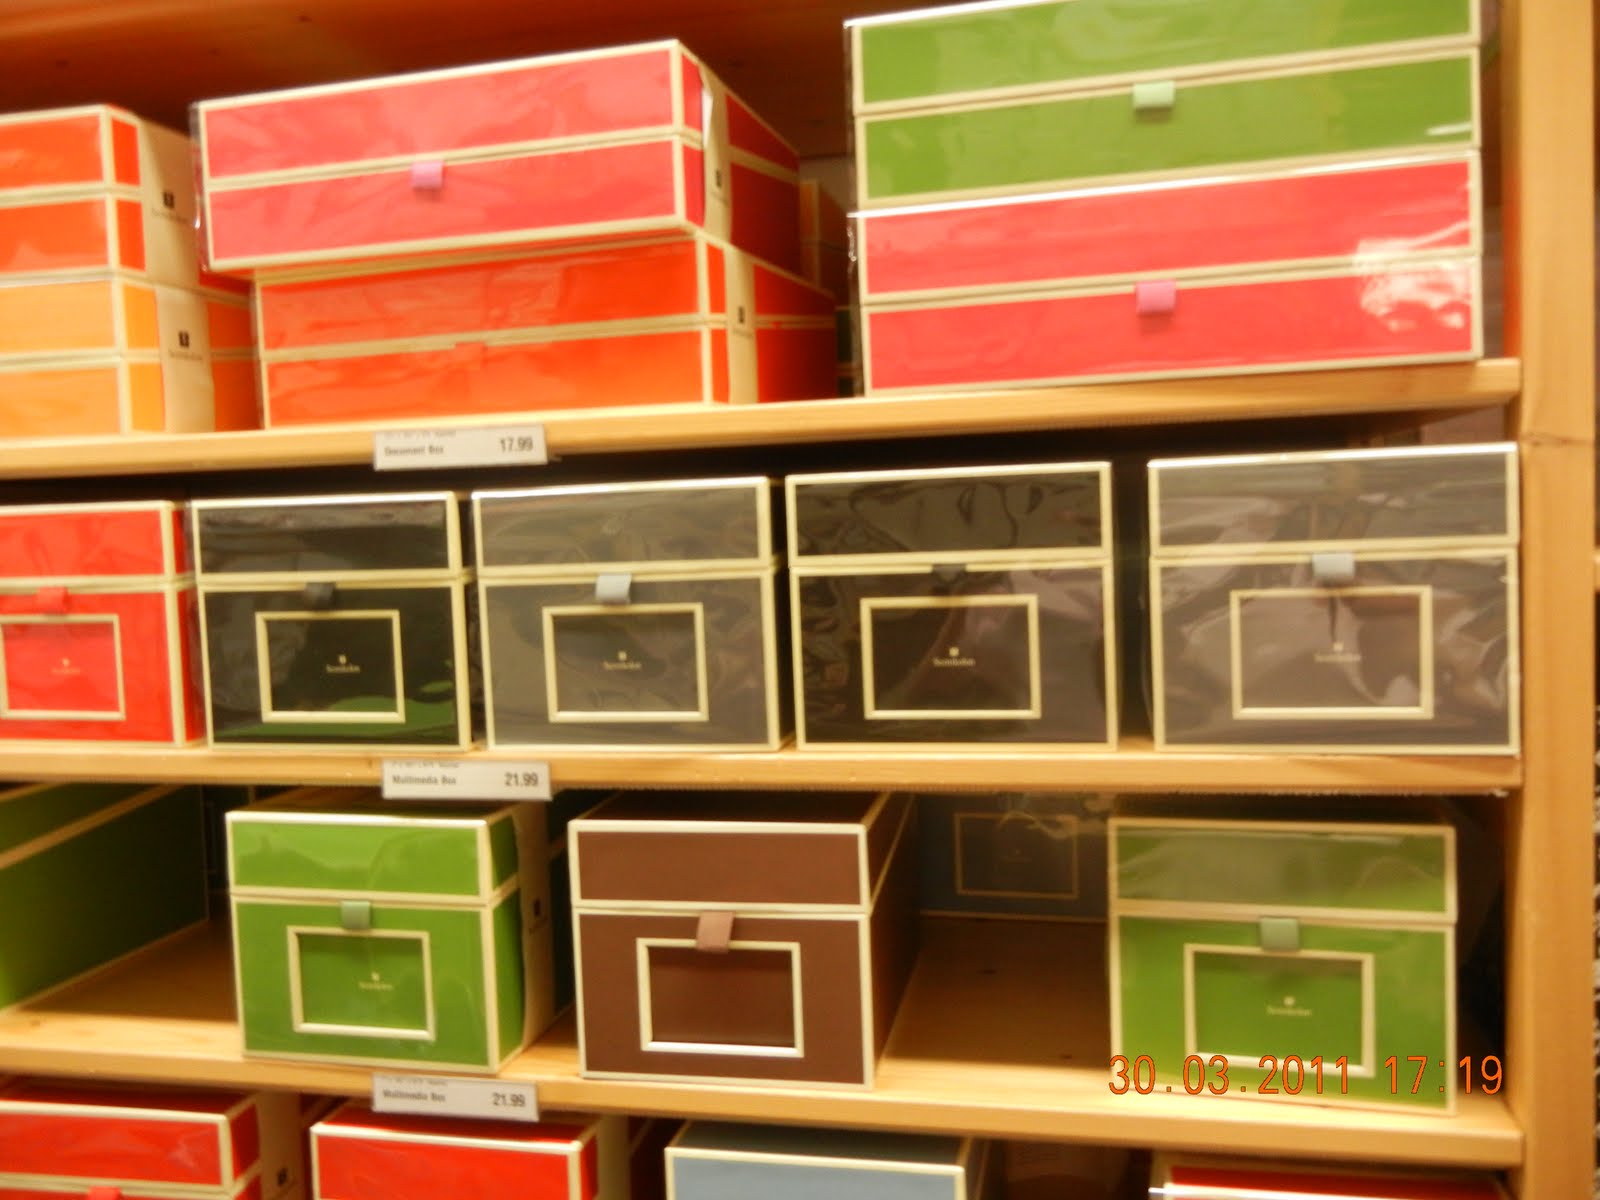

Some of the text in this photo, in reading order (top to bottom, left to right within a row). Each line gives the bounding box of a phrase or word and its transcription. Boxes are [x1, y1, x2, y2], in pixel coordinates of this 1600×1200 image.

[500, 436, 533, 453] 17.99
[392, 774, 438, 785] Multimedia
[504, 771, 539, 786] 21.99
[491, 1092, 526, 1107] 21.99
